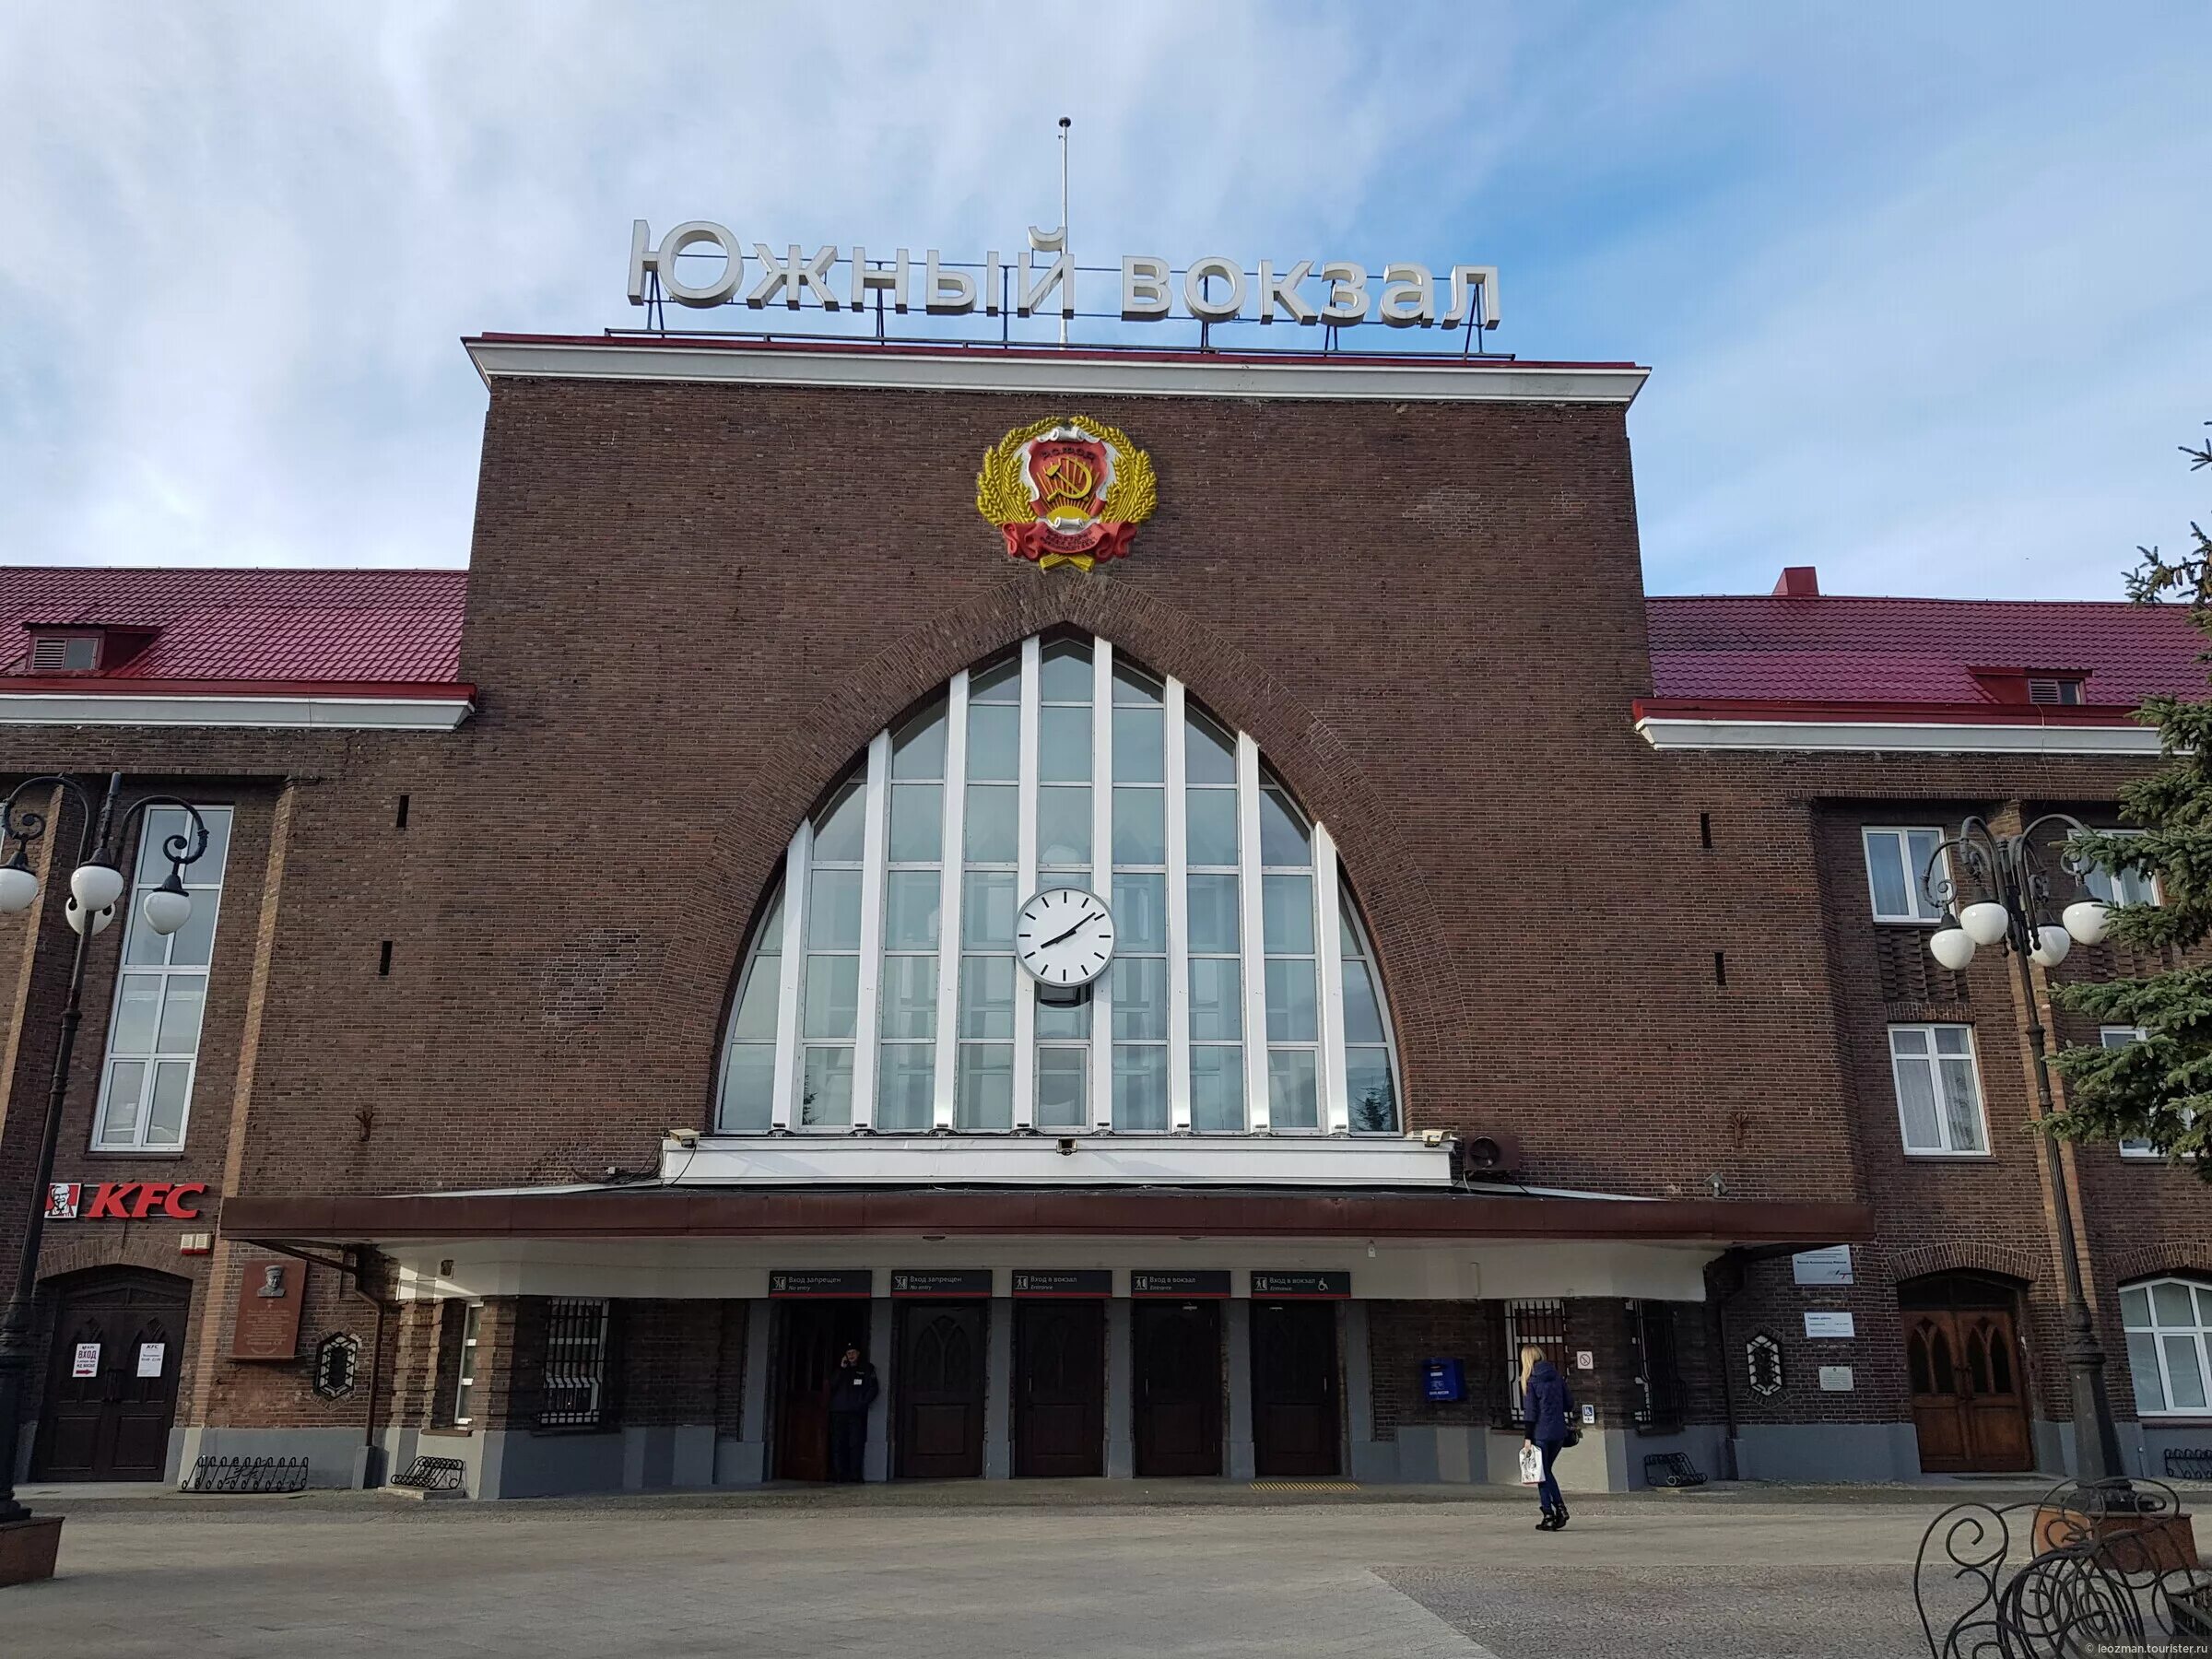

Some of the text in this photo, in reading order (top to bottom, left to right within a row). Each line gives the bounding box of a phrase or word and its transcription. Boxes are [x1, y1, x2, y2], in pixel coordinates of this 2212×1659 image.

[85, 1182, 206, 1218] KFC
[806, 1277, 841, 1285] запрещен
[928, 1277, 961, 1285] запрещен
[78, 1350, 96, 1359] ВХОД
